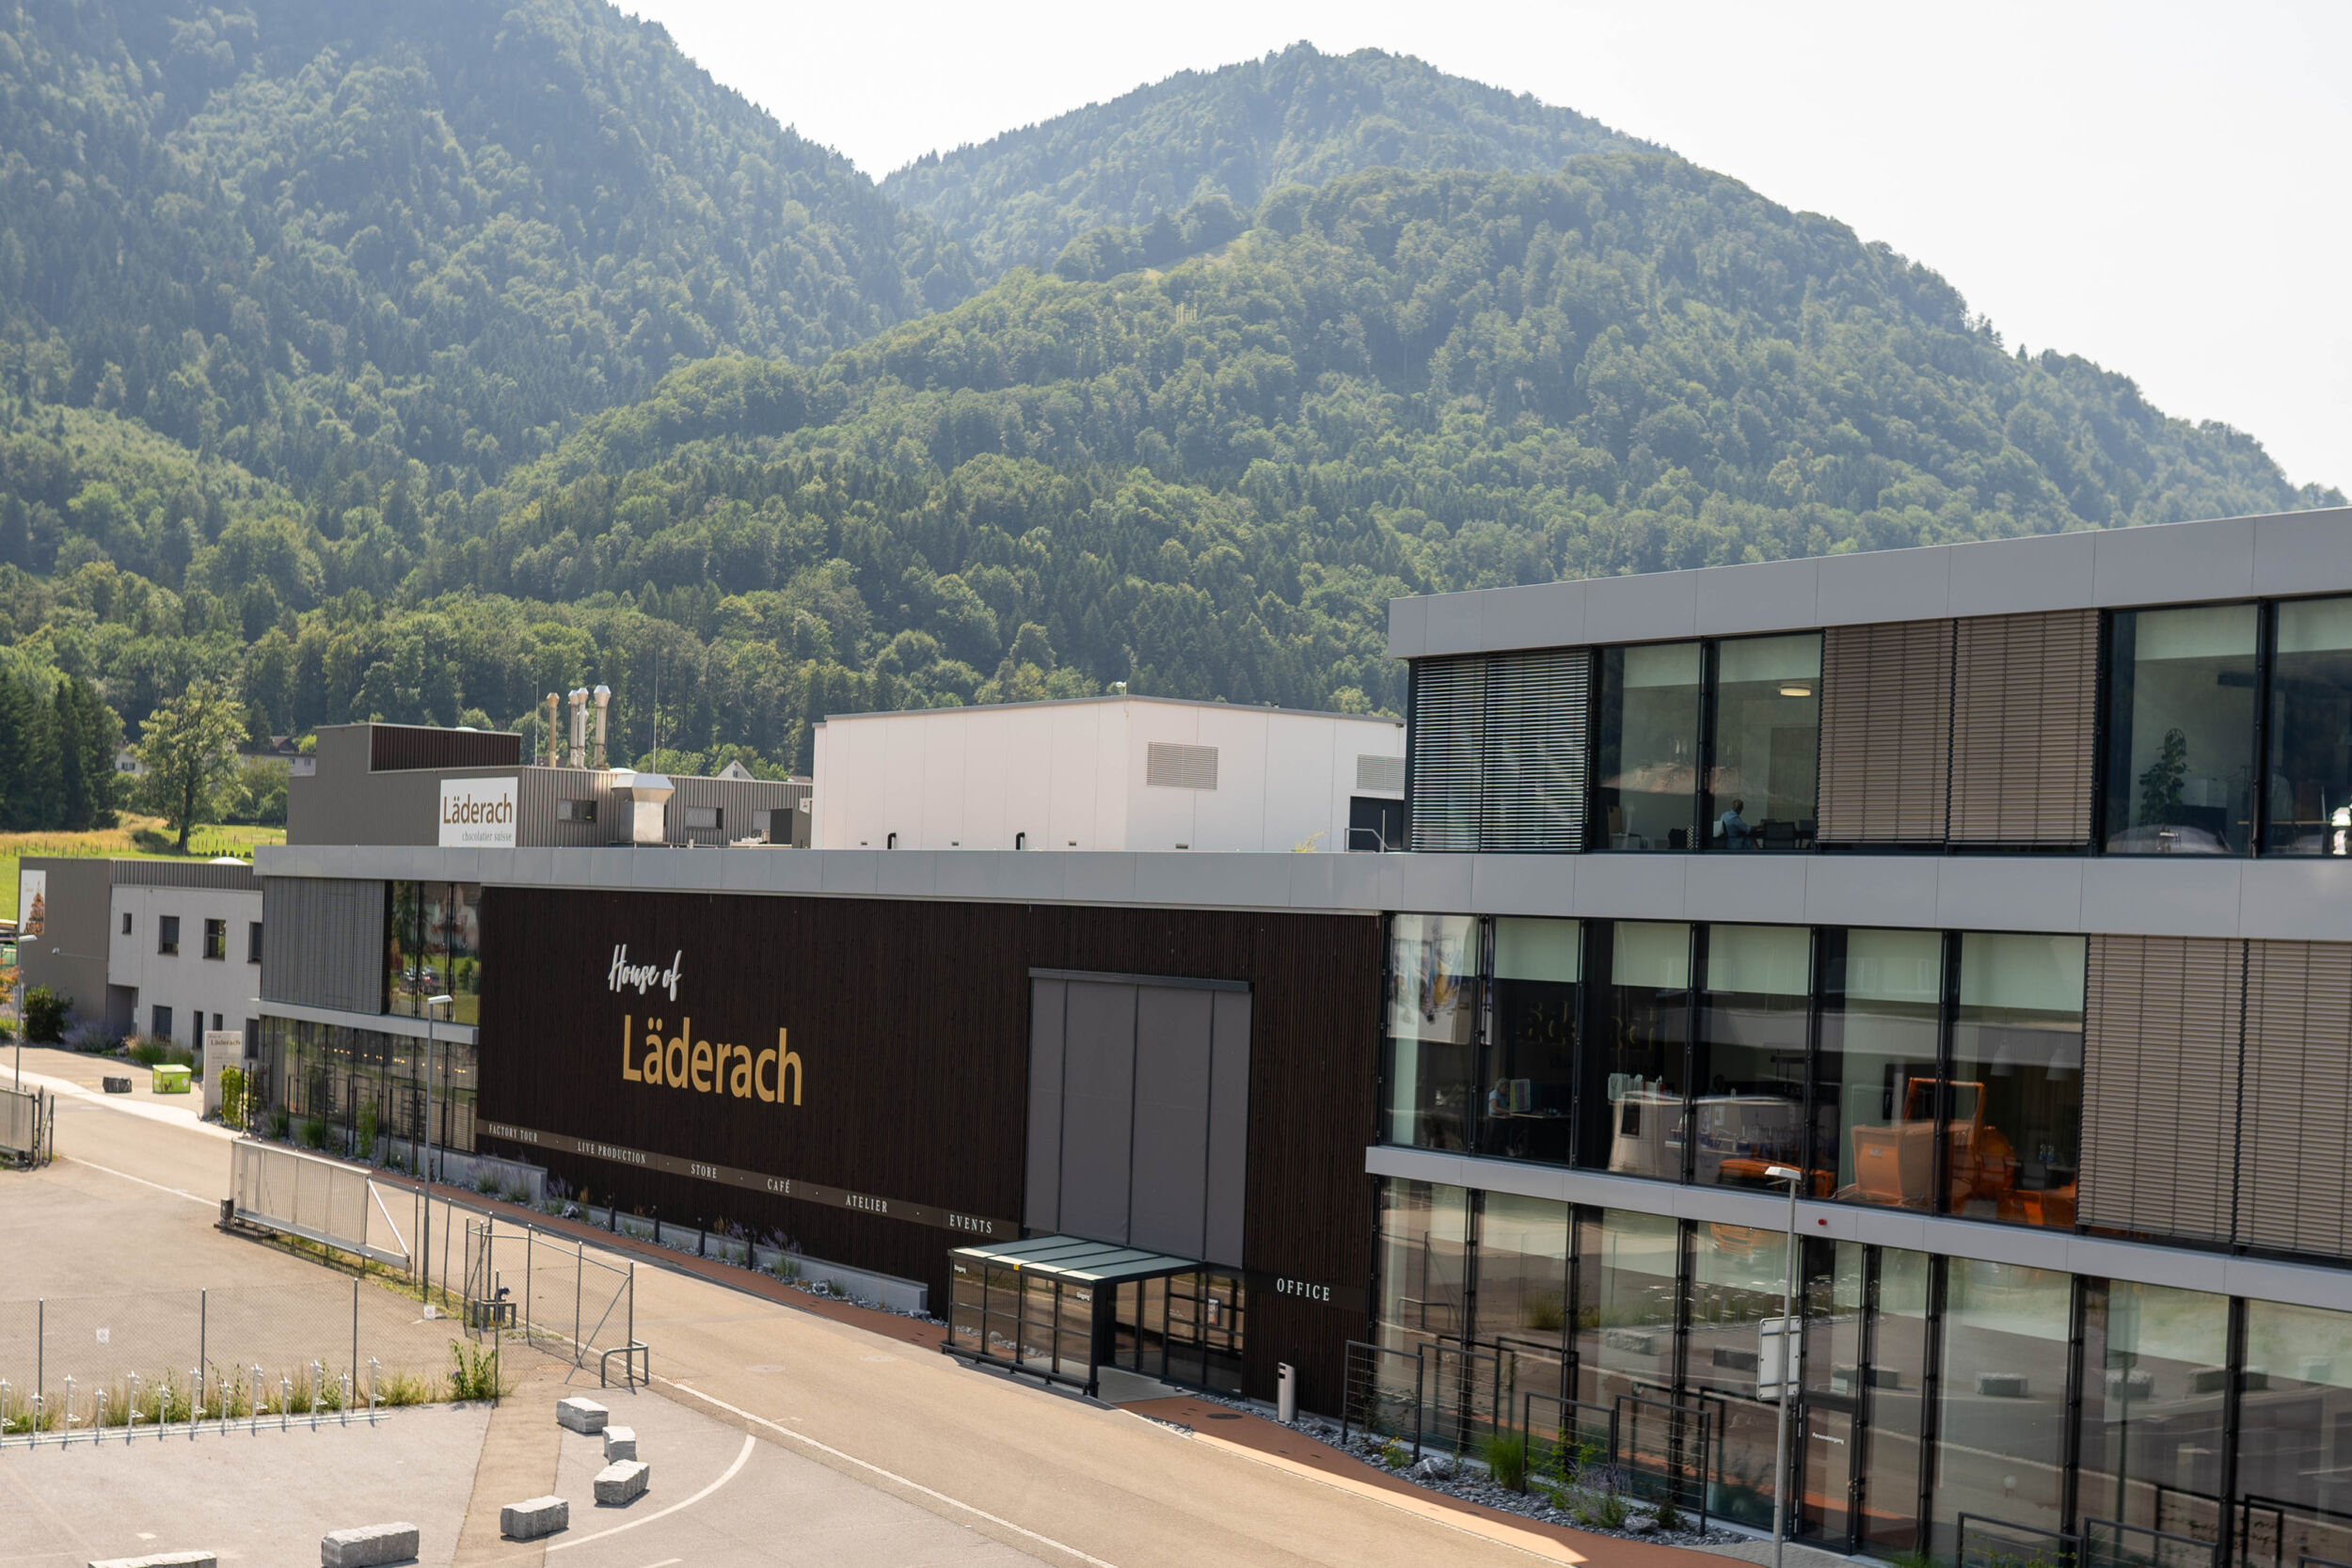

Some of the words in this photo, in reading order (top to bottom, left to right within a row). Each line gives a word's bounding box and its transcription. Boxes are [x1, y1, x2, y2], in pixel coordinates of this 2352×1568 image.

[443, 792, 513, 824] Läderach
[462, 831, 492, 842] chocolatier
[494, 831, 512, 842] suisse
[608, 943, 660, 995] House
[662, 949, 683, 1002] of
[623, 1014, 803, 1106] Läderach
[488, 1123, 517, 1138] FACTORY
[520, 1130, 538, 1143] TOUR
[578, 1141, 596, 1154] LIVE
[597, 1146, 646, 1164] PRODUCTION
[691, 1164, 717, 1180] STORE
[767, 1178, 790, 1194] CAFÉ
[845, 1194, 888, 1213] ATELIER
[949, 1213, 993, 1234] EVENTS
[1277, 1277, 1330, 1302] OFFICE
